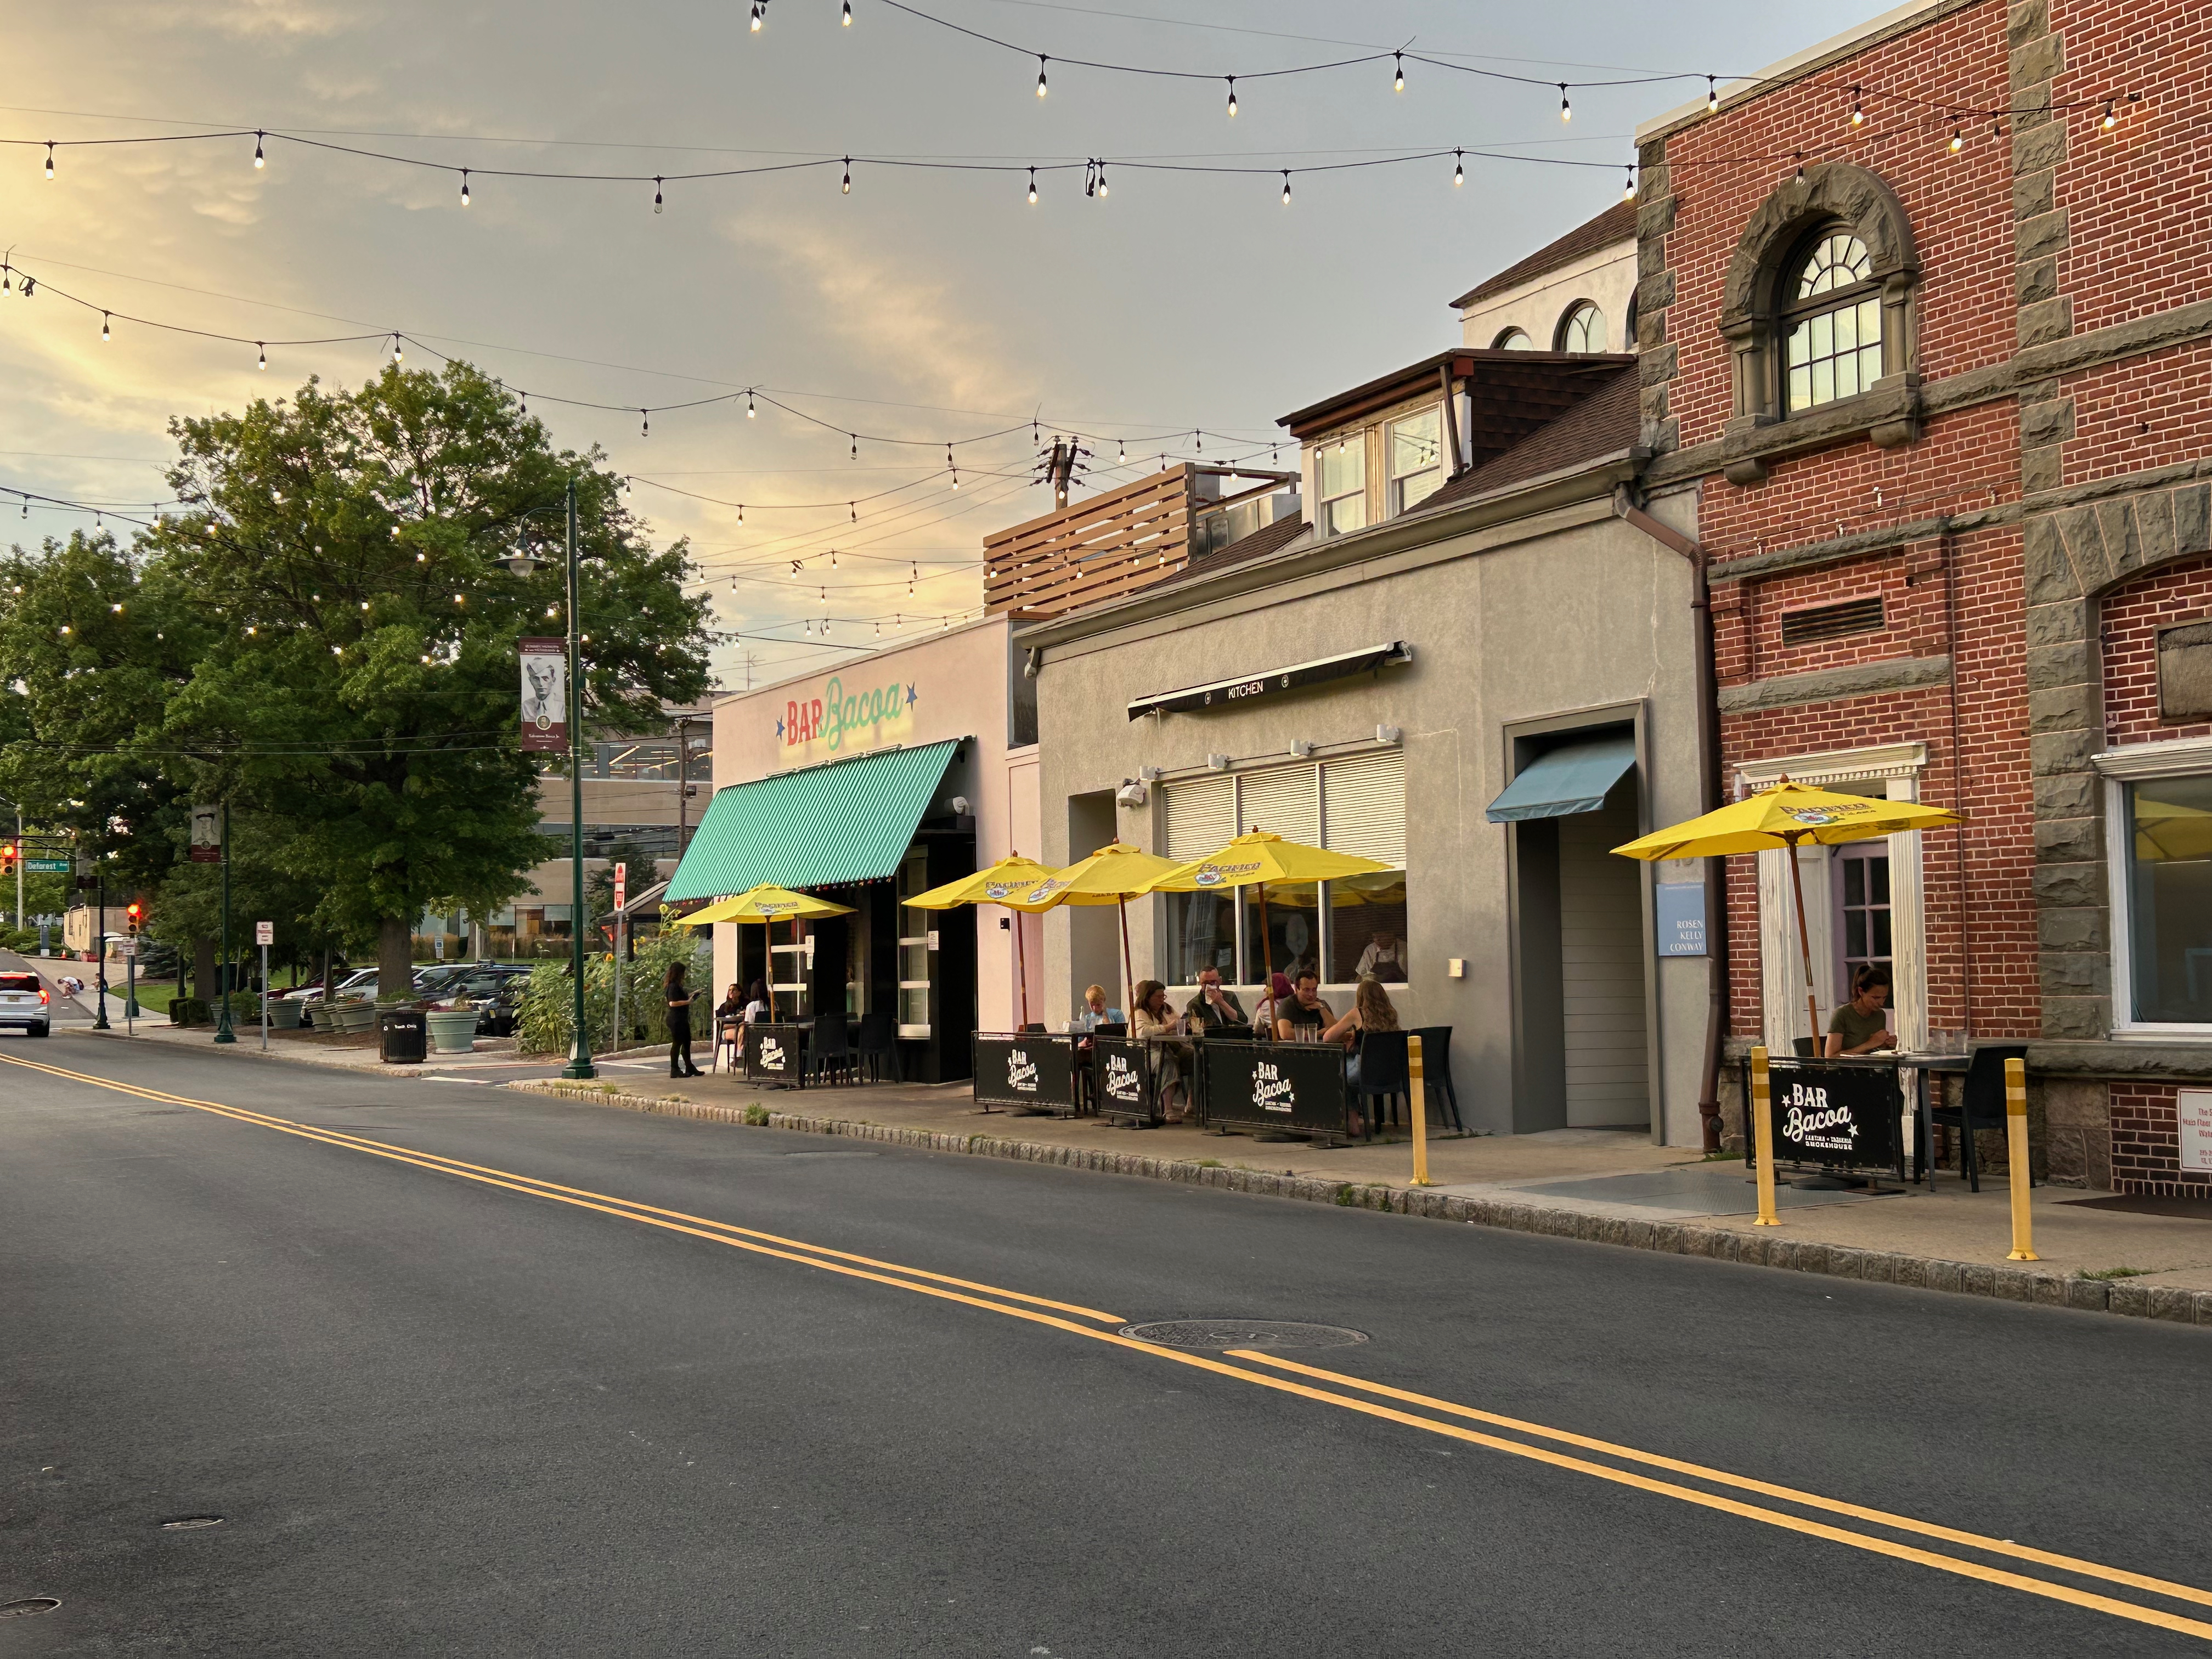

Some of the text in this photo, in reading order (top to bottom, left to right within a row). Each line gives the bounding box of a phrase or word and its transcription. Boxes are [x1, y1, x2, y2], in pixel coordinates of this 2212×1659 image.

[1228, 681, 1263, 699] KITCHEN
[787, 676, 904, 751] BAR Bacoa
[1677, 920, 1703, 929] ROSEN
[1680, 931, 1703, 940] KELLY
[1670, 943, 1703, 952] CONWAY
[1110, 1054, 1127, 1072] BAR
[1258, 1062, 1278, 1080] BAR
[1106, 1070, 1138, 1096] Bacoa
[1252, 1079, 1291, 1107] Bacoa
[1792, 1083, 1829, 1108] BAR
[1783, 1105, 1852, 1142] Bacoa
